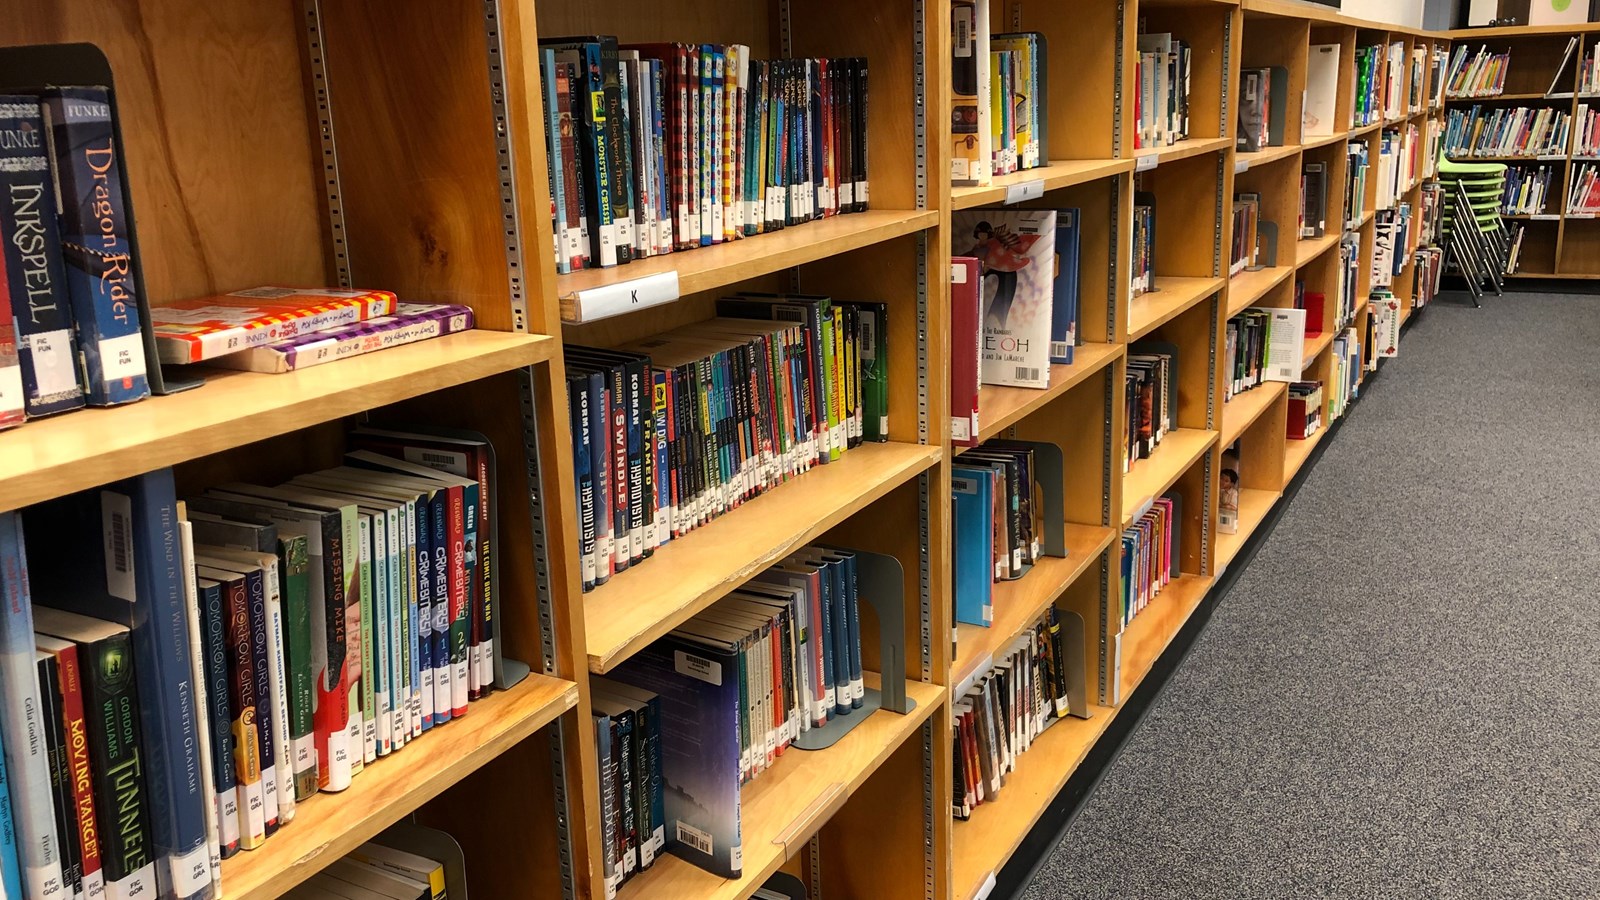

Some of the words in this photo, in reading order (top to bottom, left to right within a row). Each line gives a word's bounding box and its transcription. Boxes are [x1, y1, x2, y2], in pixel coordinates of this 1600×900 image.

[67, 104, 108, 118] FUNKE
[0, 130, 40, 150] UNKE
[610, 117, 620, 166] Clockwork
[597, 135, 608, 186] MONSTER
[85, 137, 117, 248] Dragon
[600, 189, 611, 225] CRUSH
[9, 182, 57, 324] INKSPELL
[100, 253, 131, 325] Rider
[631, 290, 638, 303] K
[1000, 337, 1029, 352] OH
[631, 374, 639, 425] KORMAN
[581, 391, 589, 445] KORMAN
[644, 420, 652, 485] FRAMED
[657, 429, 666, 449] DOG
[616, 414, 627, 504] SWINDLE
[630, 465, 642, 528] HYPNOTISTS
[161, 505, 171, 528] THE
[582, 487, 594, 553] HYPNOTISTS
[164, 529, 173, 566] WIND
[482, 540, 490, 554] THE
[168, 567, 176, 578] IN
[332, 538, 343, 600] MISSING
[434, 547, 448, 627] CRIMEBITERS!
[454, 541, 466, 620] CRIMEBITERS!
[418, 551, 430, 632] CRIMEBITERS!
[234, 581, 251, 665] TOMORROW
[251, 572, 267, 654] TOMORROW
[335, 607, 344, 643] MIKE
[171, 611, 183, 662] WILLOWS
[208, 589, 224, 674] TOMORROW
[424, 643, 429, 654] 1
[442, 639, 446, 649] 1
[458, 632, 464, 643] 2
[241, 669, 253, 707] GIRLS
[257, 659, 269, 695] GIRLS
[25, 697, 34, 722] Celia
[215, 678, 228, 716] GIRLS
[27, 722, 38, 755] Godkin
[103, 700, 118, 759] WILLIAMS
[120, 696, 134, 745] GORDON
[178, 682, 189, 734] KENNETH
[184, 737, 197, 795] GRAHAME
[264, 729, 269, 740] Me
[602, 754, 612, 785] THE
[71, 719, 89, 792] MOVING
[80, 793, 97, 858] TARGET
[251, 802, 262, 810] GRA
[267, 786, 276, 794] GRA
[106, 748, 146, 874] TUNNELS
[226, 807, 237, 816] GRA
[604, 787, 614, 864] FLEDGLING
[44, 877, 56, 887] FIC
[72, 863, 80, 881] Beth
[89, 880, 99, 889] FIC
[130, 879, 141, 888] FIC
[193, 869, 205, 879] GRA
[194, 863, 203, 872] FIC
[43, 885, 60, 895] GOD
[129, 886, 143, 897] GOR
